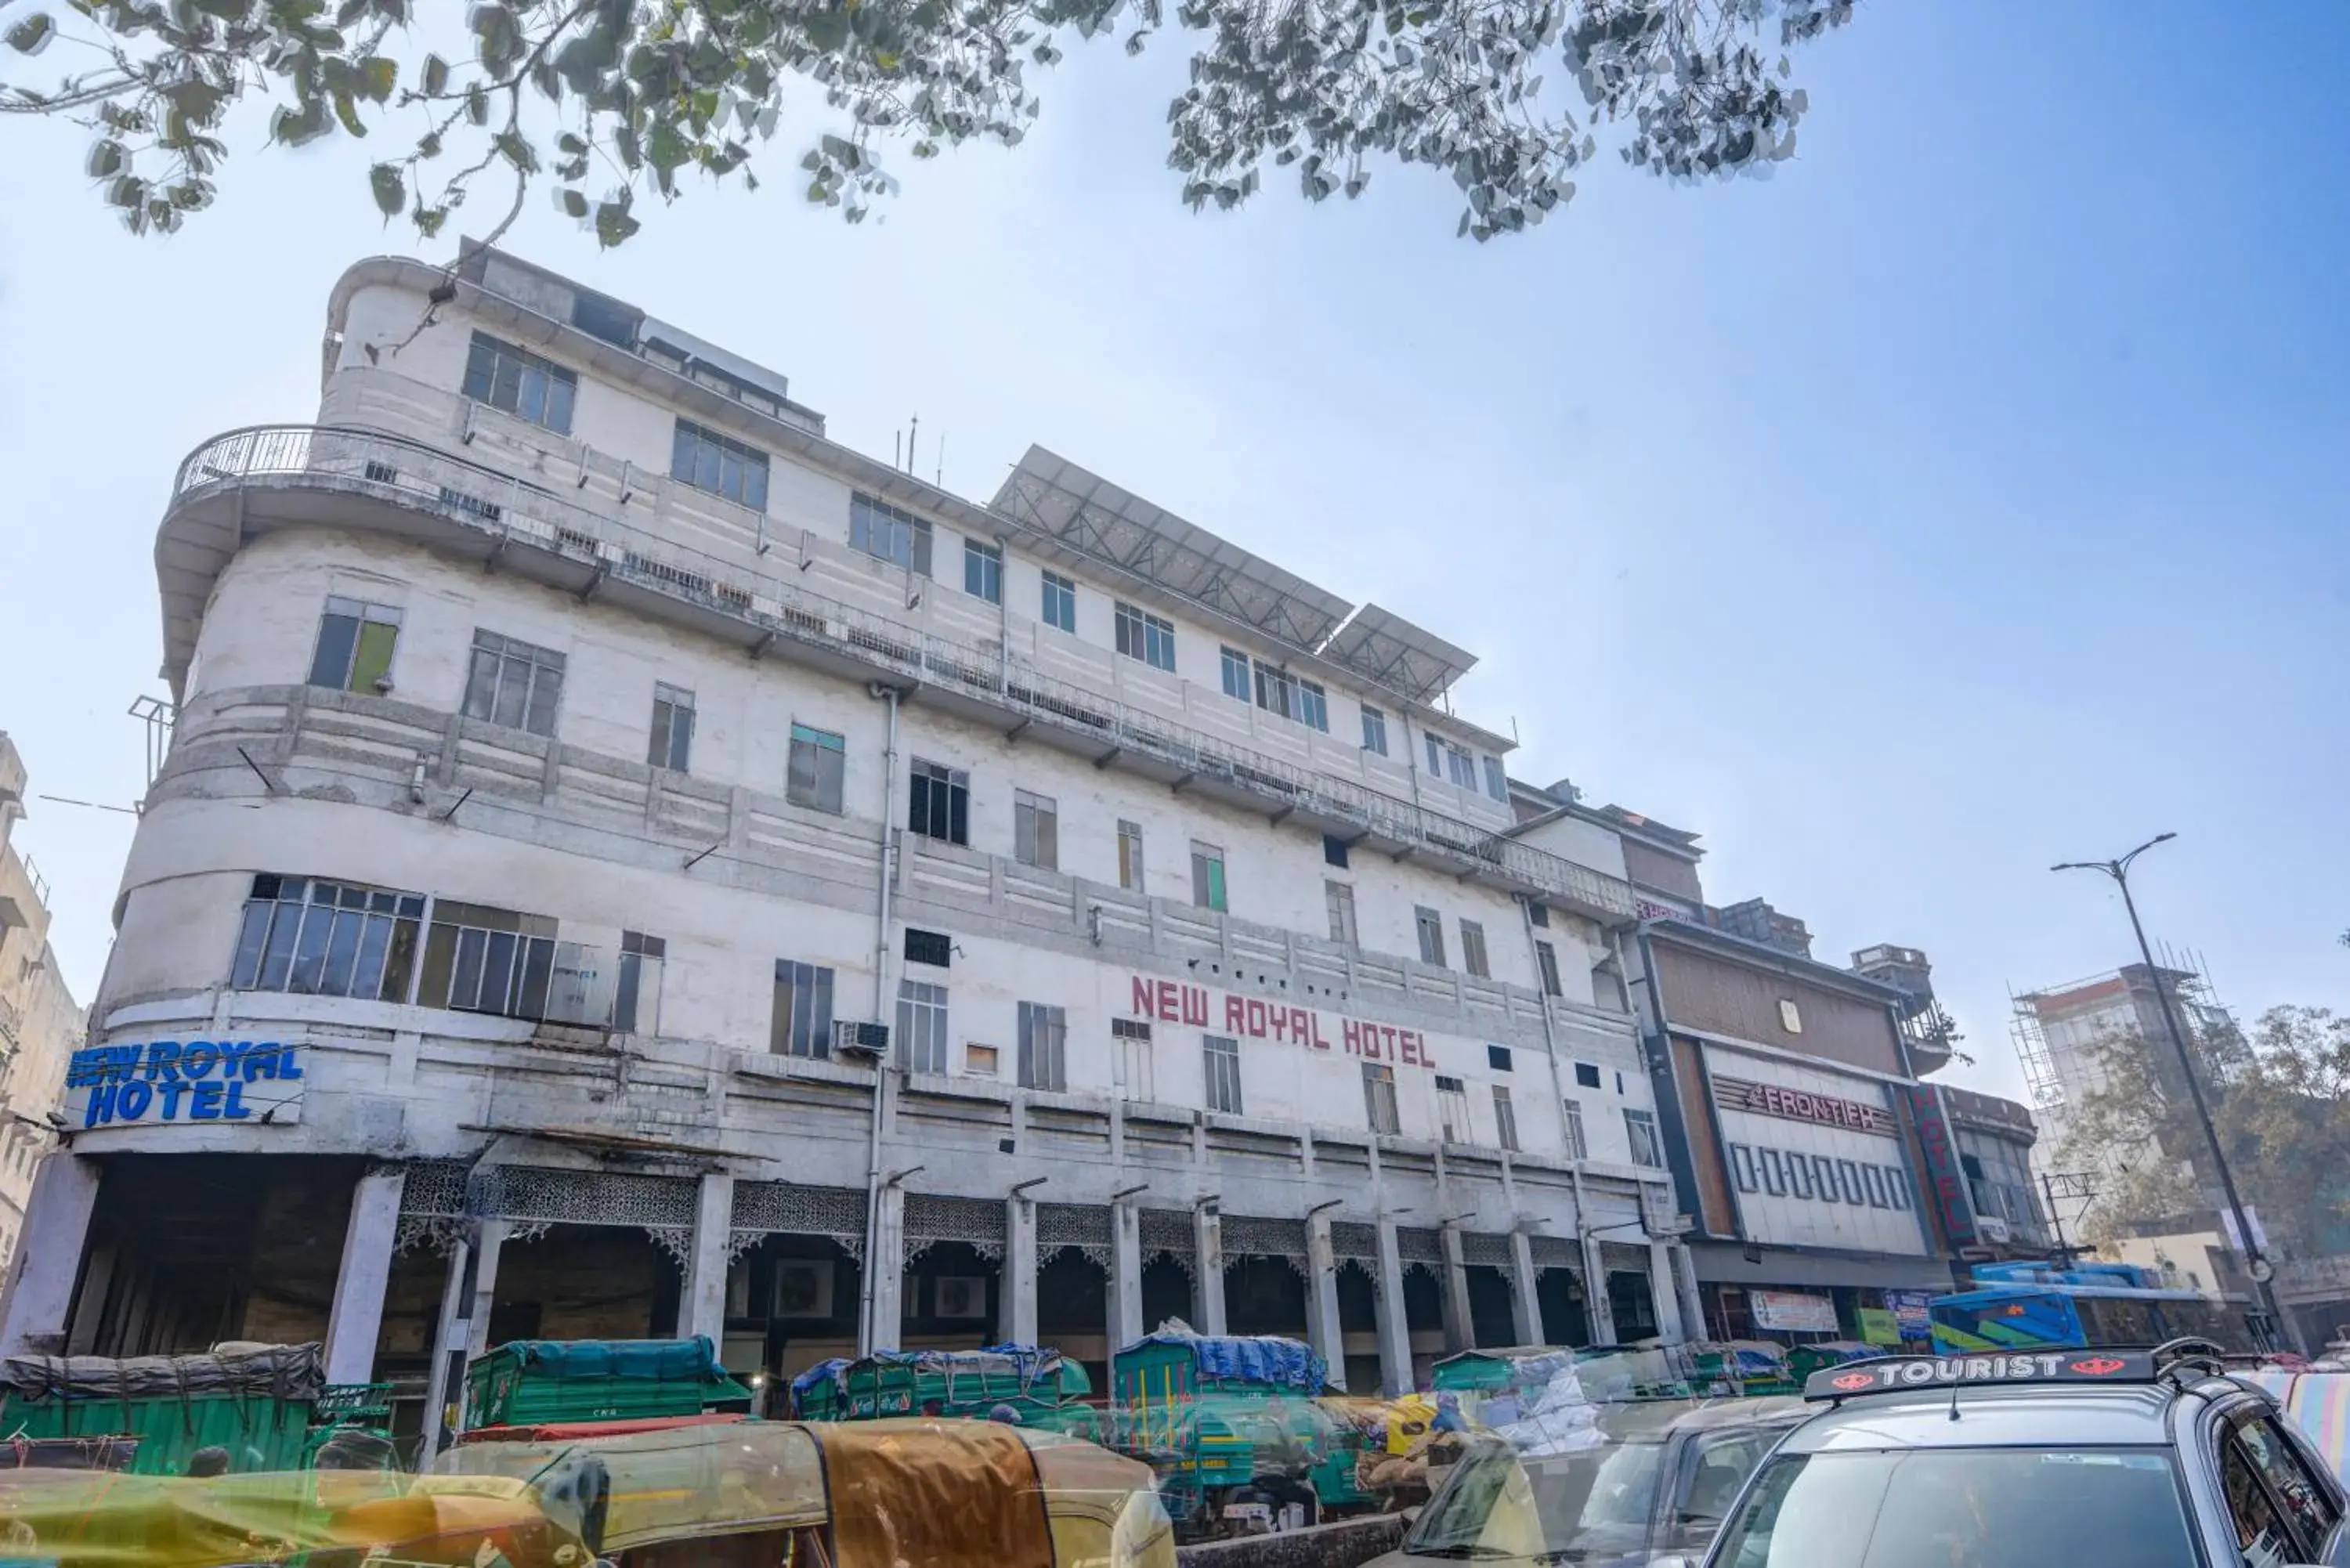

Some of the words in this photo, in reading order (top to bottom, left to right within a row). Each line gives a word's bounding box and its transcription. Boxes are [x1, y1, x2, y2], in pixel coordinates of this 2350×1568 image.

[1133, 977, 1207, 1027] NEW
[1225, 995, 1329, 1050] ROYAL
[1343, 1017, 1436, 1068] HOTEL
[66, 1044, 143, 1088] NEW
[144, 1041, 303, 1082] ROYAL
[85, 1078, 251, 1129] HOTEL
[1764, 1088, 1875, 1129] FRONTIER
[1914, 1085, 1969, 1230] HOTEL
[1878, 1356, 2066, 1386] TOURIST
